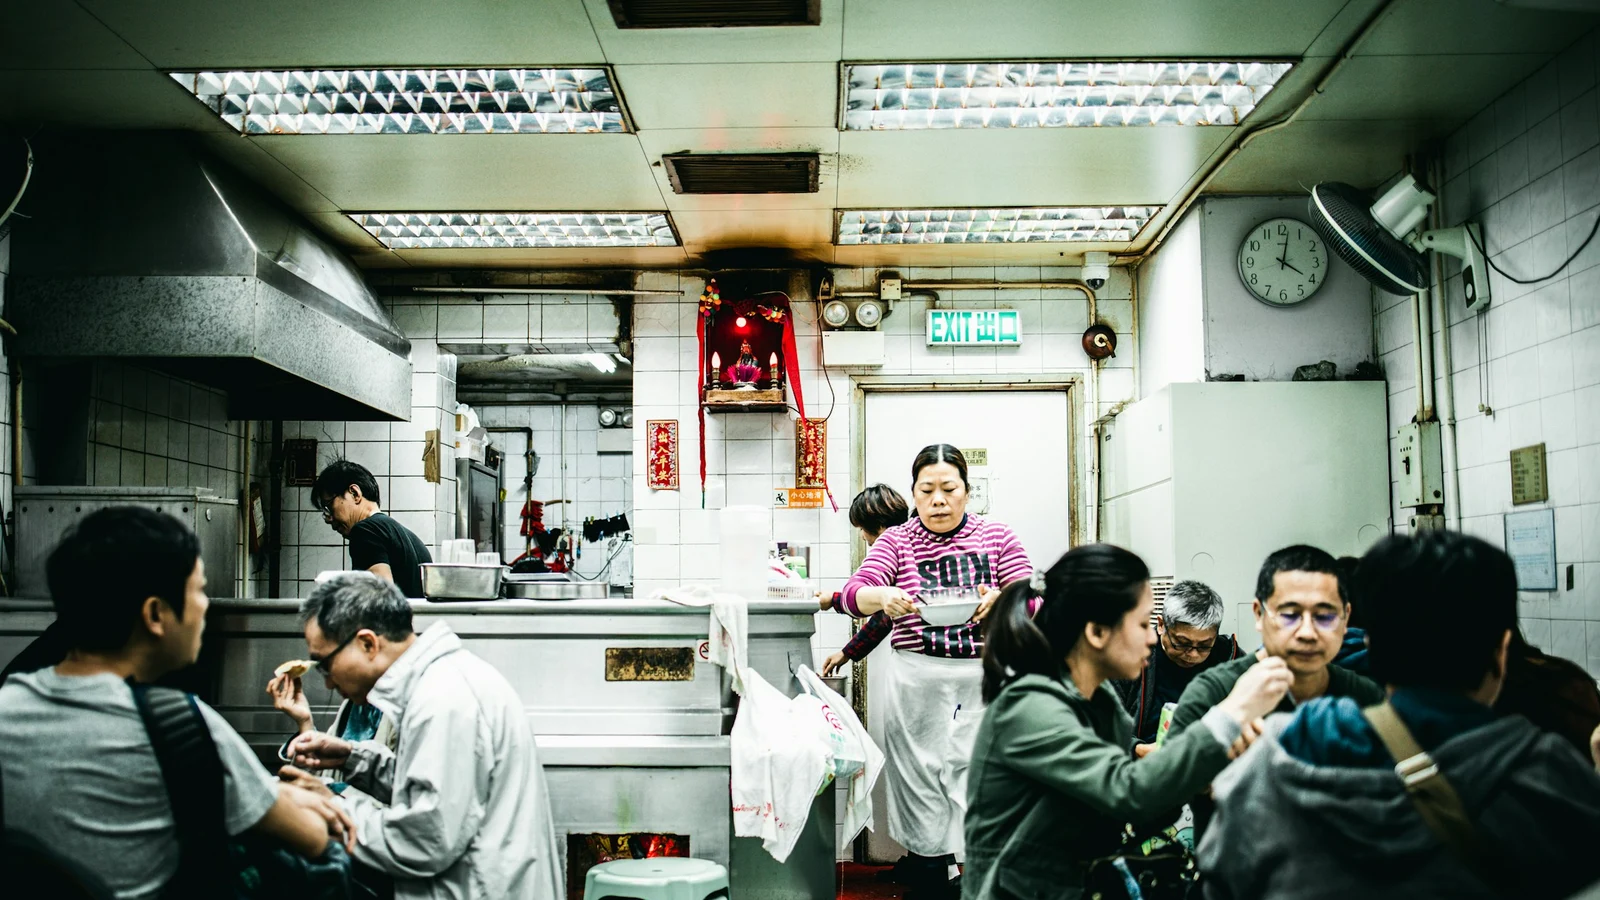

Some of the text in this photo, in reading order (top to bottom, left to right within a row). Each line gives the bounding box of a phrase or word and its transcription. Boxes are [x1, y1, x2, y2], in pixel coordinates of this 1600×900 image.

[1264, 229, 1271, 240] 11
[1277, 224, 1287, 236] 12
[1298, 229, 1301, 240] 1
[1250, 240, 1260, 252] 10
[1309, 240, 1316, 252] 2
[1246, 257, 1254, 268] 9
[1313, 257, 1320, 269] 3
[1250, 273, 1258, 285] 8
[1308, 273, 1316, 285] 4
[1264, 285, 1272, 297] 7
[1279, 289, 1288, 301] 6
[1297, 285, 1305, 297] 5
[931, 311, 1018, 342] EXIT 出口
[656, 431, 671, 480] 出入平安
[790, 490, 822, 499] 小心地滑
